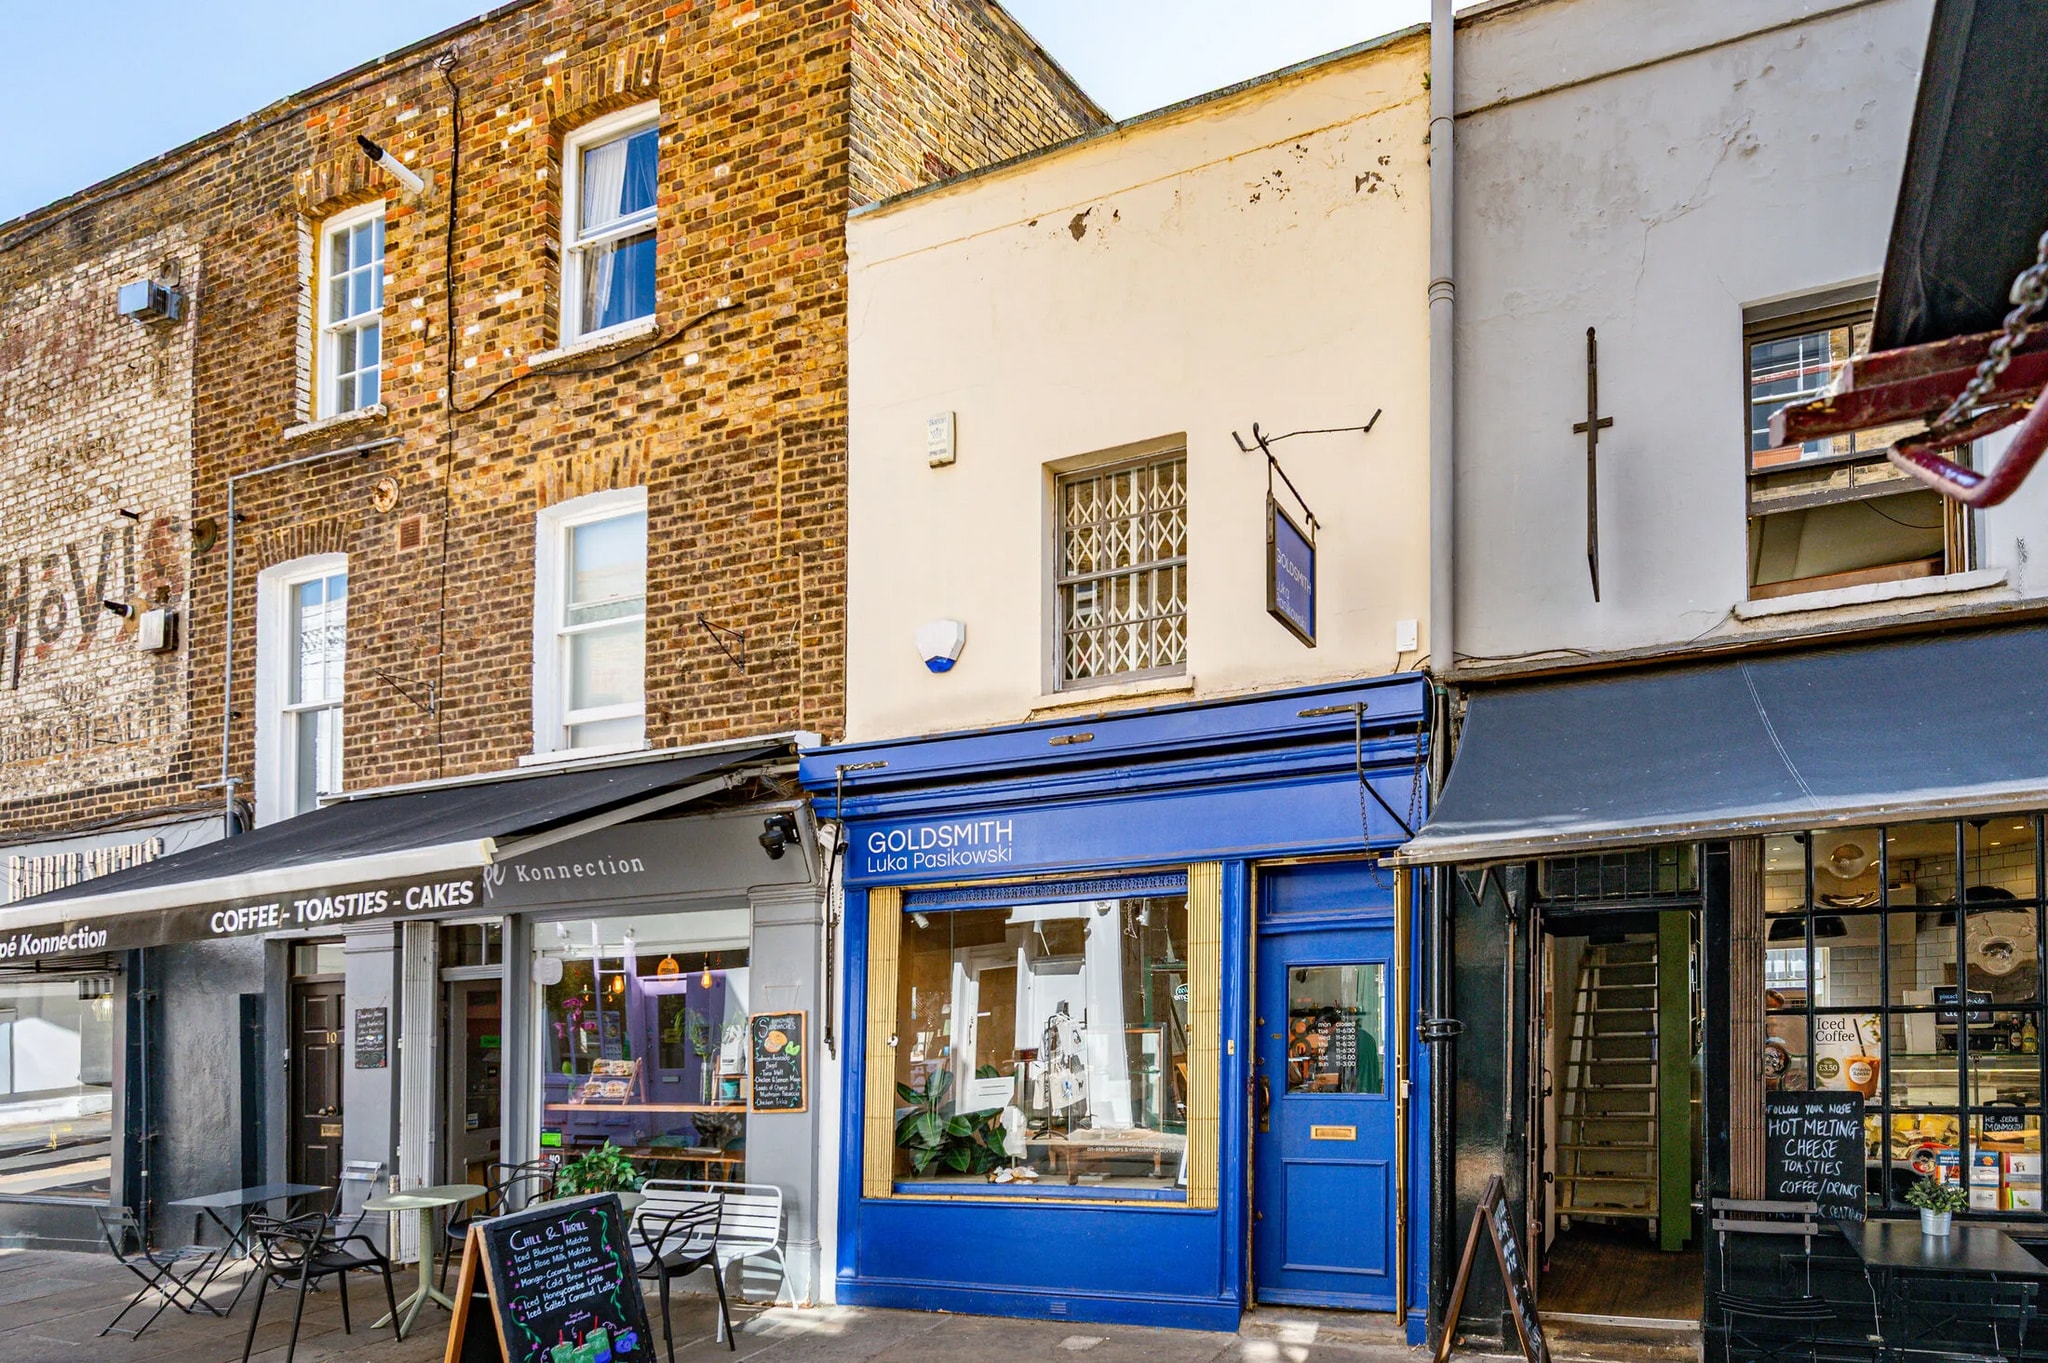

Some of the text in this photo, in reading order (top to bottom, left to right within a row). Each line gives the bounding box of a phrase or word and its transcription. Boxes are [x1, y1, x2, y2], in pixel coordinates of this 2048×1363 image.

[868, 819, 1013, 854] GOLDSMITH
[515, 855, 645, 882] Konnection
[867, 843, 1012, 873] Luka Pasikowski
[210, 880, 474, 934] COFFEE TOASTIES CAKES
[18, 925, 108, 956] Konnection
[1815, 1030, 1855, 1042] Coffee
[1817, 1018, 1846, 1030] Iced
[326, 1032, 338, 1044] 10
[1819, 1064, 1838, 1072] £3.50
[1805, 1104, 1824, 1114] YOUR
[1999, 1115, 2019, 1123] SERVE
[1768, 1118, 1860, 1140] HOT MELTING
[1984, 1122, 2023, 1132] MONMOUTH
[1784, 1138, 1839, 1158] CHEESE
[1781, 1160, 1843, 1176] TOASTIES
[510, 1219, 589, 1251] CHILL & THRILL
[514, 1236, 589, 1264] Iced Blueberry Matcha
[517, 1246, 592, 1275] Iced Rose Milk Matcha
[520, 1264, 571, 1288] Mango-Coconut
[573, 1257, 599, 1269] Matcha
[546, 1273, 583, 1290] Cold Brew
[523, 1296, 540, 1310] Iced
[587, 1275, 604, 1286] Latte
[526, 1282, 616, 1320] Iced Salted Caramel Latte
